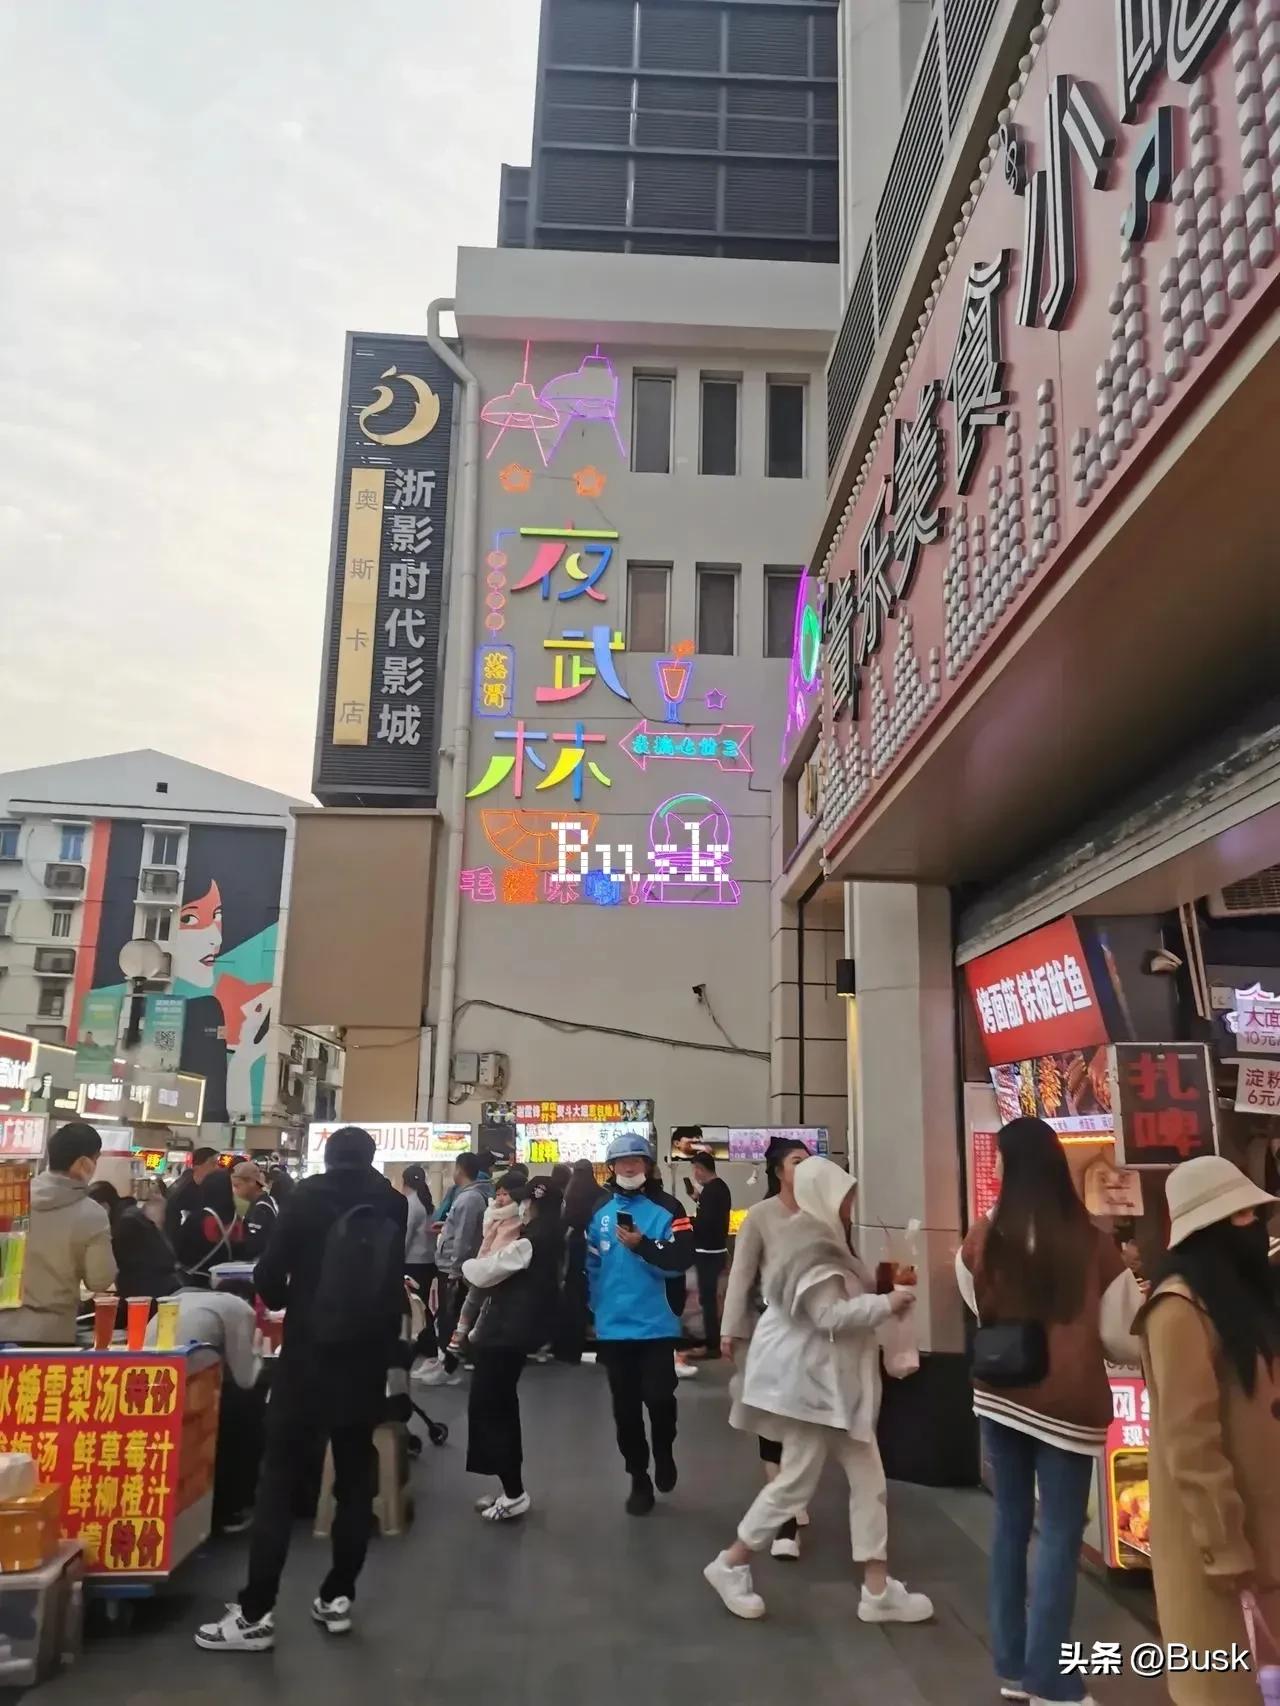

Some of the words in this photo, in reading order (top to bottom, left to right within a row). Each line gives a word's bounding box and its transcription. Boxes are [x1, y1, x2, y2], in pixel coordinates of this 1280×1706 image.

[339, 489, 379, 724] 奥斯卡店
[377, 468, 436, 746] 浙影时代影城
[466, 520, 631, 800] 夜武林
[976, 976, 1025, 1034] 烤面筋
[1015, 954, 1093, 1024] 铁板鱿鱼
[1127, 1051, 1203, 1158] 扎啤
[67, 1473, 170, 1518] 鲜柳橙汁
[72, 1429, 175, 1473] 鲜草莓汁
